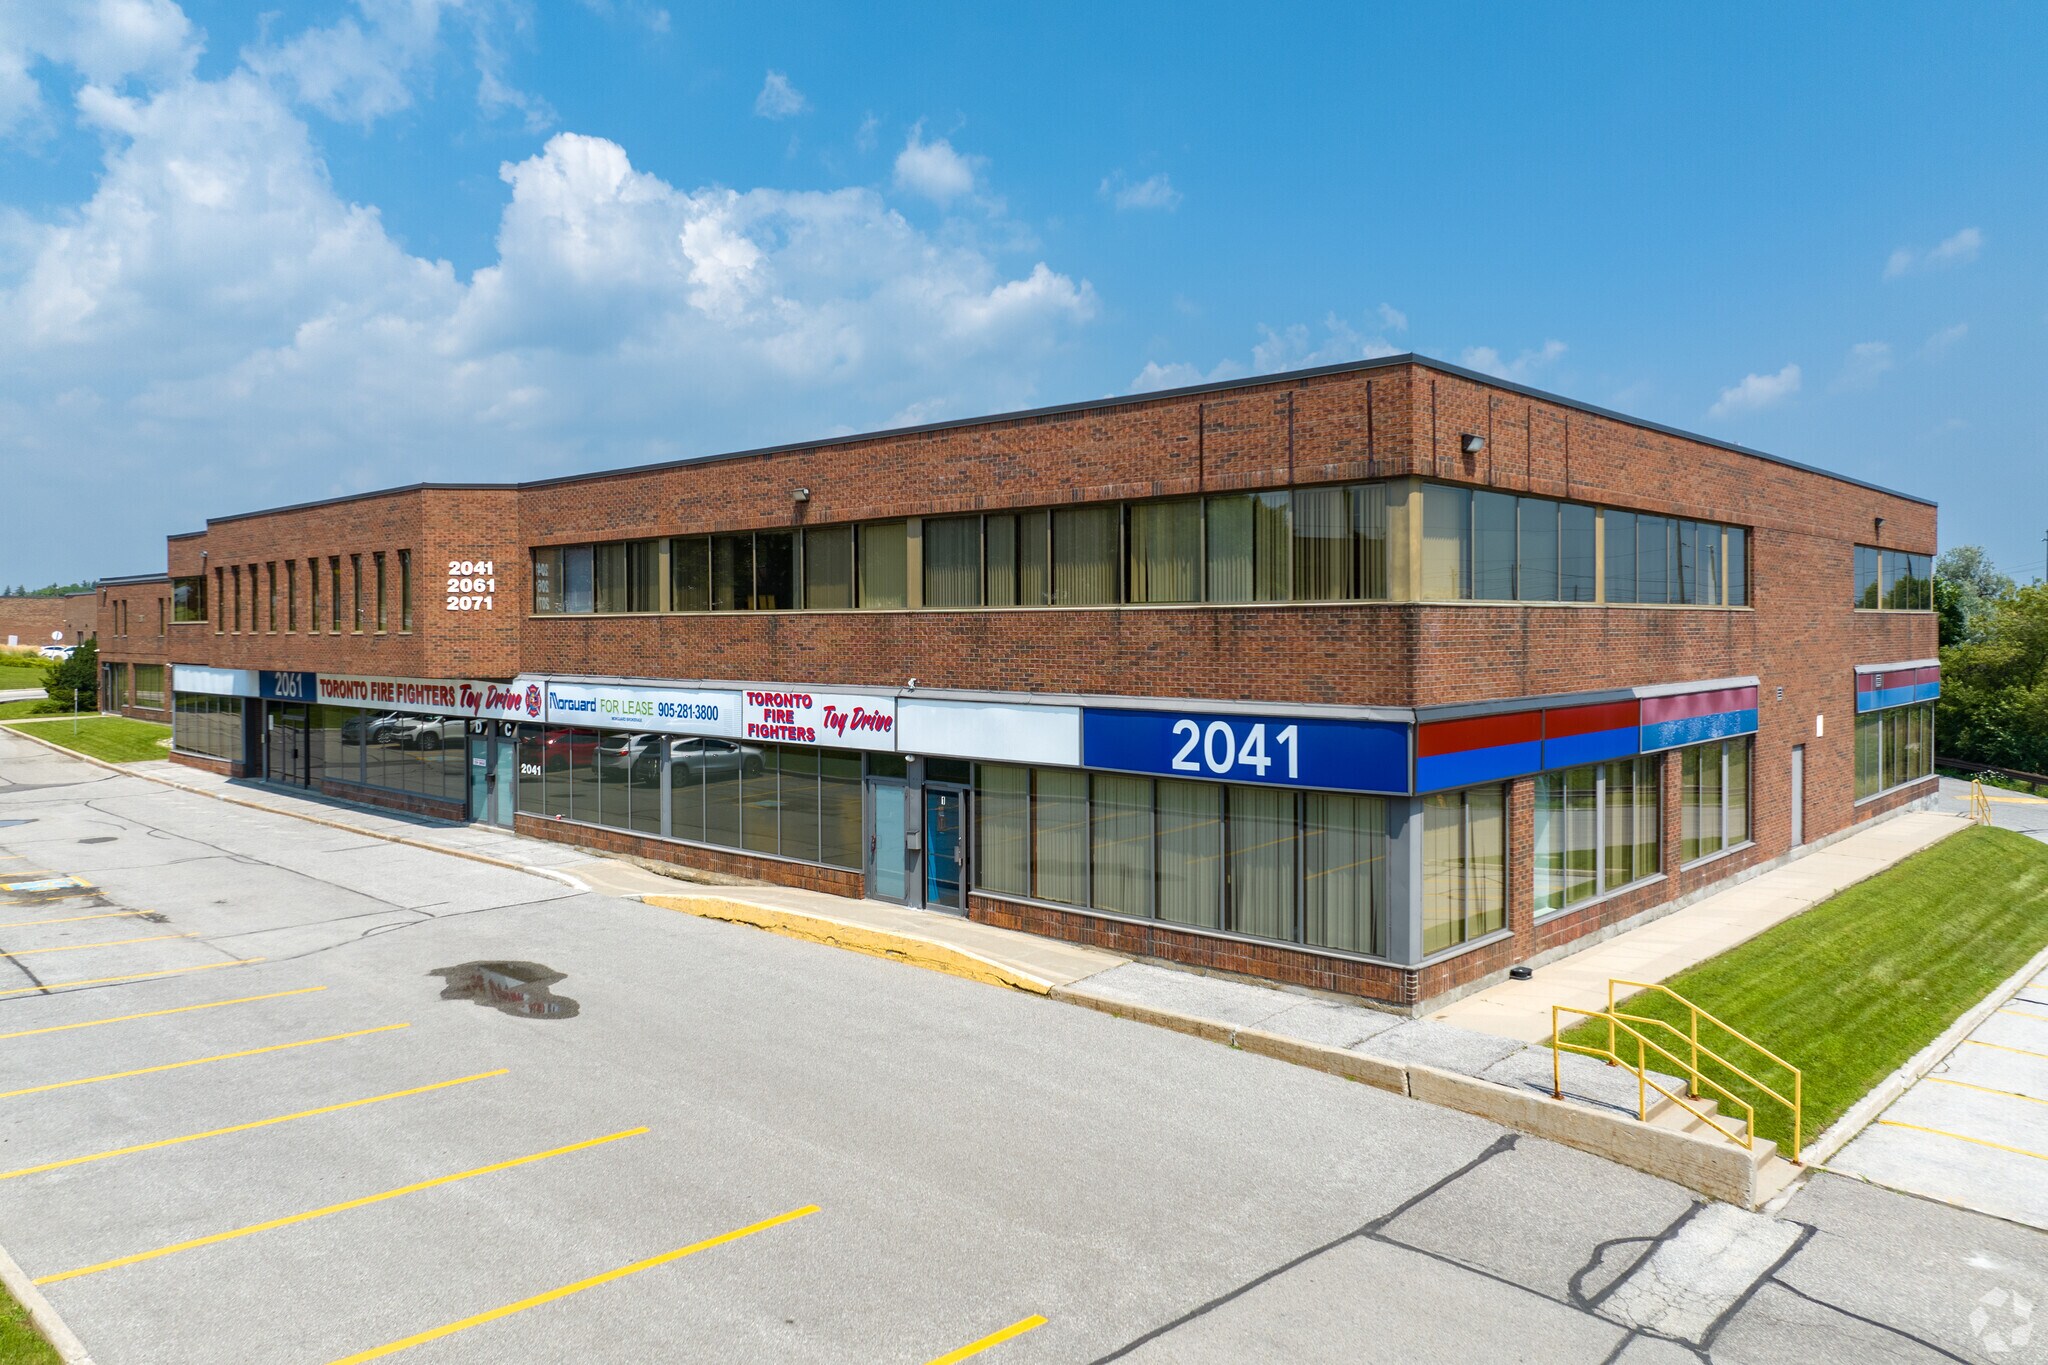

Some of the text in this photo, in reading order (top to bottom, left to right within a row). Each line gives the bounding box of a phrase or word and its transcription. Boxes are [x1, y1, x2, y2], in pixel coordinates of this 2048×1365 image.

[448, 561, 493, 576] 2041
[447, 578, 495, 593] 2061
[446, 596, 492, 611] 2071
[274, 672, 303, 698] 2061
[319, 678, 368, 701] TORONTO
[370, 681, 395, 703] FIRE
[396, 683, 456, 708] FIGHTERS
[459, 683, 483, 717] Toy
[485, 684, 523, 711] Drive
[549, 692, 596, 713] Morguard
[600, 699, 619, 714] FOR
[622, 700, 654, 716] LEASE
[658, 702, 719, 721] 905-281-3800
[746, 691, 813, 710] TORONTO
[763, 708, 795, 725] FIRE
[823, 705, 893, 738] Toy Drive
[475, 720, 483, 734] D
[504, 723, 512, 737] C
[747, 723, 816, 743] FIGHTERS
[1172, 719, 1298, 779] 2041
[520, 763, 541, 776] 2041
